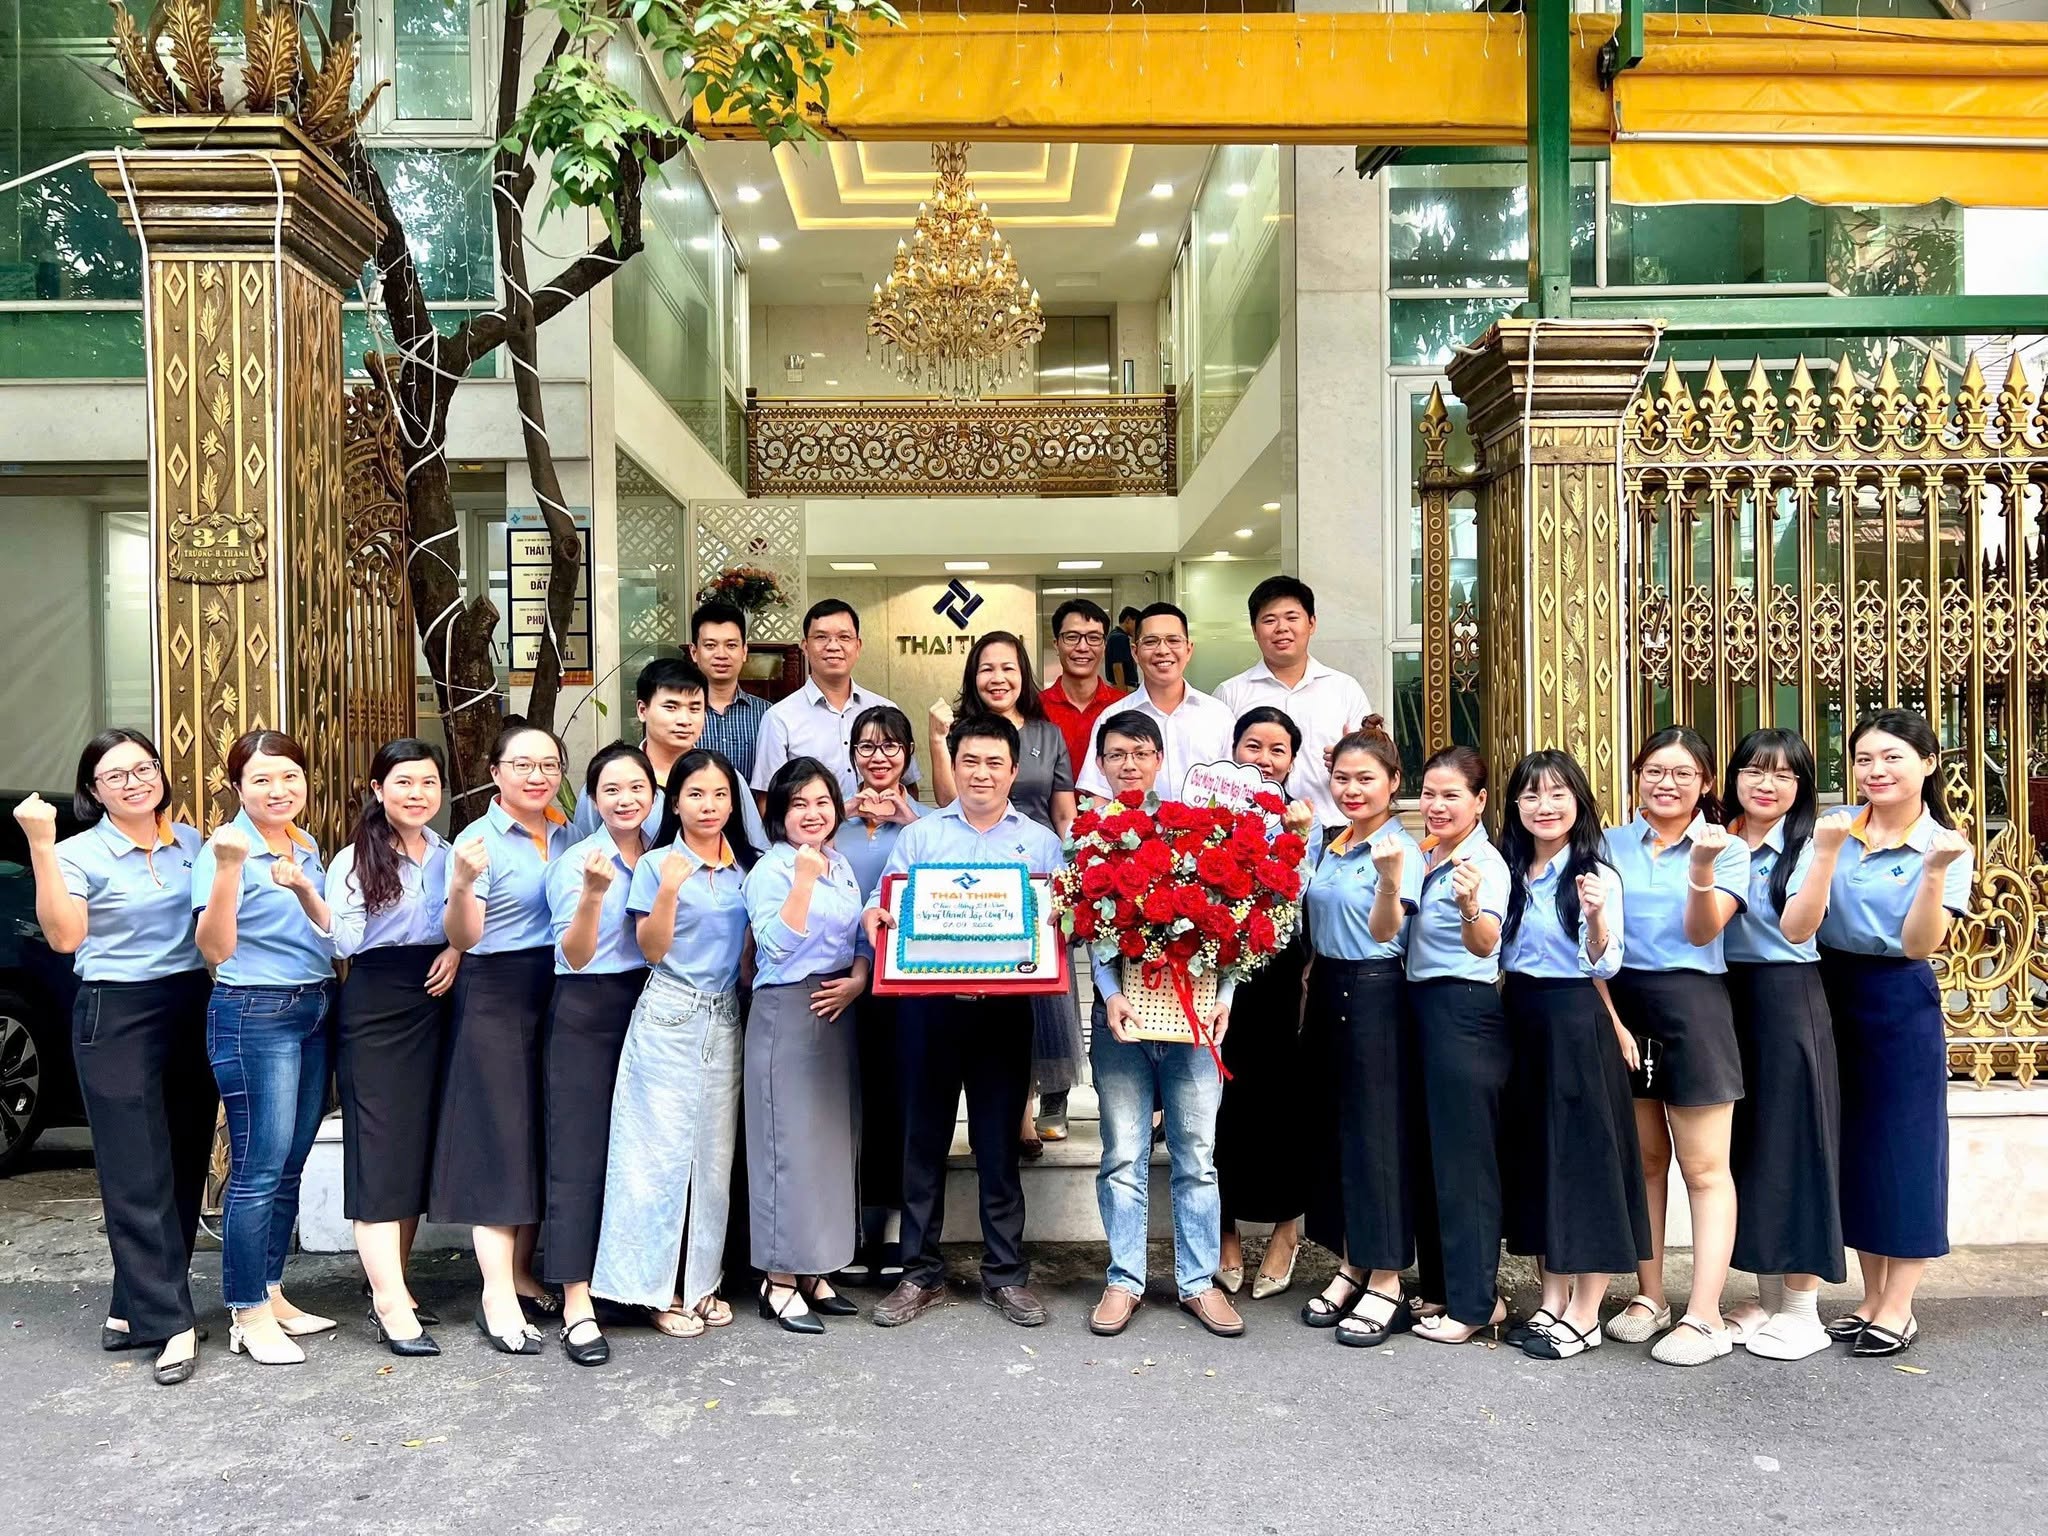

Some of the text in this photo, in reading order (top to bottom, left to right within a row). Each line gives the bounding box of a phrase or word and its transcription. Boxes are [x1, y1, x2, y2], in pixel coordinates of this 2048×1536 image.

[192, 528, 241, 548] 34
[896, 634, 952, 655] THAI
[930, 892, 1007, 900] THAI THINH
